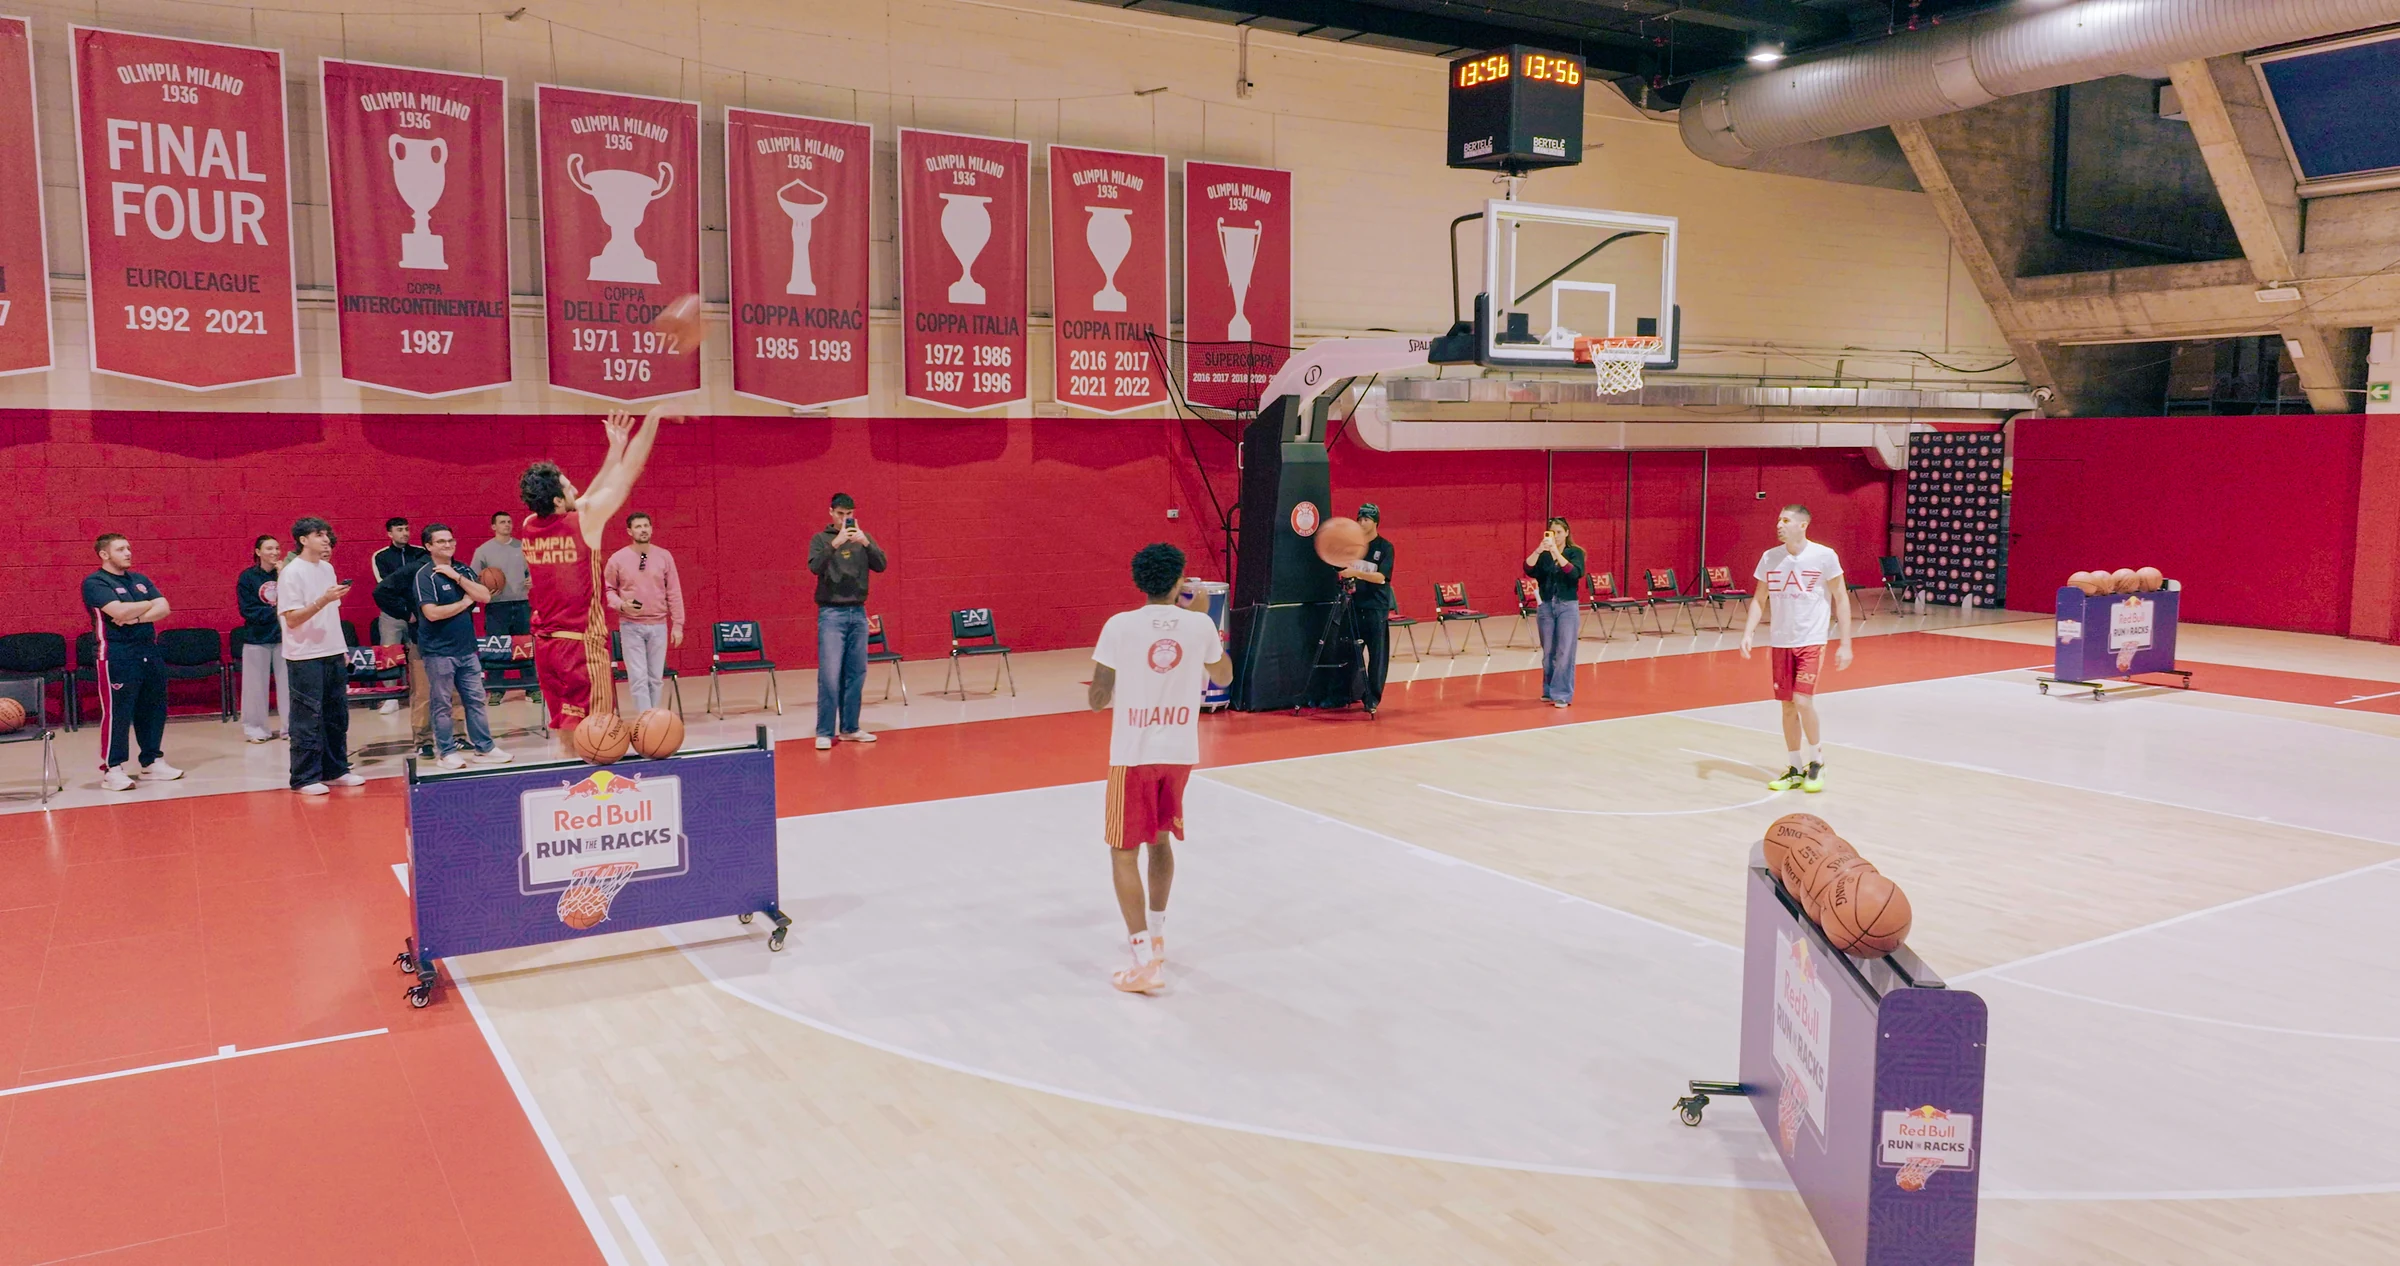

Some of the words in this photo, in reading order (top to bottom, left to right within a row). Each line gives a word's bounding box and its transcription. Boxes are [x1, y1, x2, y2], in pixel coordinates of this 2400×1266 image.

[117, 63, 181, 84] OLIMPIA
[186, 65, 244, 96] MILANO
[1460, 56, 1509, 87] 13:56
[1527, 55, 1580, 85] 13:56
[162, 84, 198, 104] 1936
[360, 91, 417, 112] OLIMPIA
[420, 93, 471, 121] MILANO
[399, 111, 431, 129] 1936
[571, 115, 620, 135] OLIMPIA
[624, 116, 669, 144] MILANO
[106, 118, 267, 183] FINAL
[604, 133, 633, 151] 1936
[757, 137, 801, 156] OLIMPIA
[804, 138, 845, 163] MILANO
[786, 154, 813, 170] 1936
[925, 154, 965, 173] OLIMPIA
[968, 155, 1005, 179] MILANO
[952, 170, 976, 186] 1936
[1072, 169, 1108, 187] OLIMPIA
[1111, 170, 1144, 192] MILANO
[1096, 185, 1118, 199] 1936
[1207, 183, 1239, 199] OLIMPIA
[1241, 184, 1272, 205] MILANO
[110, 182, 269, 246] FOUR
[1228, 197, 1248, 212] 1936
[126, 267, 260, 294] EUROLEAGUE
[407, 282, 442, 295] COPPA
[604, 287, 645, 302] COPPA
[343, 295, 504, 318] INTERCONTINENTALE
[564, 300, 620, 323] DELLE
[626, 304, 667, 325] COP
[741, 303, 800, 327] COPPA
[804, 301, 863, 330] KORAĆ
[125, 305, 190, 333] 1992
[205, 309, 268, 336] 2021
[916, 312, 969, 334] COPPA
[972, 314, 1019, 337] ITALIA
[1062, 320, 1111, 341] COPPA
[1114, 321, 1155, 342] ITALIA
[401, 329, 454, 355] 1987
[572, 328, 619, 353] 1971
[632, 331, 680, 355] 1972
[755, 337, 799, 360] 1985
[808, 339, 852, 362] 1993
[925, 344, 964, 366] 1972
[972, 345, 1012, 368] 1986
[1070, 350, 1107, 371] 2016
[1114, 352, 1150, 372] 2017
[1205, 352, 1274, 368] SUPERCOPPA
[603, 358, 651, 382] 1976
[1193, 373, 1211, 383] 2016
[1212, 373, 1230, 383] 2017
[1231, 373, 1249, 384] 2018
[1250, 374, 1267, 384] 2020
[925, 371, 964, 393] 1987
[972, 372, 1012, 394] 1996
[1070, 376, 1107, 397] 2021
[1114, 377, 1150, 397] 2022
[522, 536, 576, 550] OLIMPIA
[1592, 574, 1609, 586] EA7
[1652, 574, 1668, 586] EA7
[1709, 567, 1727, 578] EA7
[1766, 570, 1822, 591] EA7
[1440, 584, 1461, 596] EA7
[961, 608, 988, 623] EA7
[1152, 619, 1179, 629] EA7
[2119, 613, 2131, 624] Red
[720, 623, 752, 637] EA7
[2114, 628, 2126, 636] RUN
[2130, 626, 2149, 635] RACKS
[351, 649, 376, 665] A7
[512, 642, 534, 660] A7
[1797, 673, 1816, 682] EA7
[554, 805, 602, 832] Red
[607, 800, 652, 826] Bull
[536, 838, 582, 859] RUN
[585, 840, 597, 850] THE
[601, 828, 671, 851] RACKS
[1784, 969, 1801, 1017] Red
[1802, 993, 1819, 1044] Bull
[1776, 1002, 1792, 1044] RUN
[1797, 1035, 1824, 1092] RACKS
[1899, 1124, 1926, 1137] Red
[1929, 1125, 1955, 1138] Bull
[1888, 1140, 1913, 1150] RUN
[1924, 1141, 1965, 1152] RACKS
